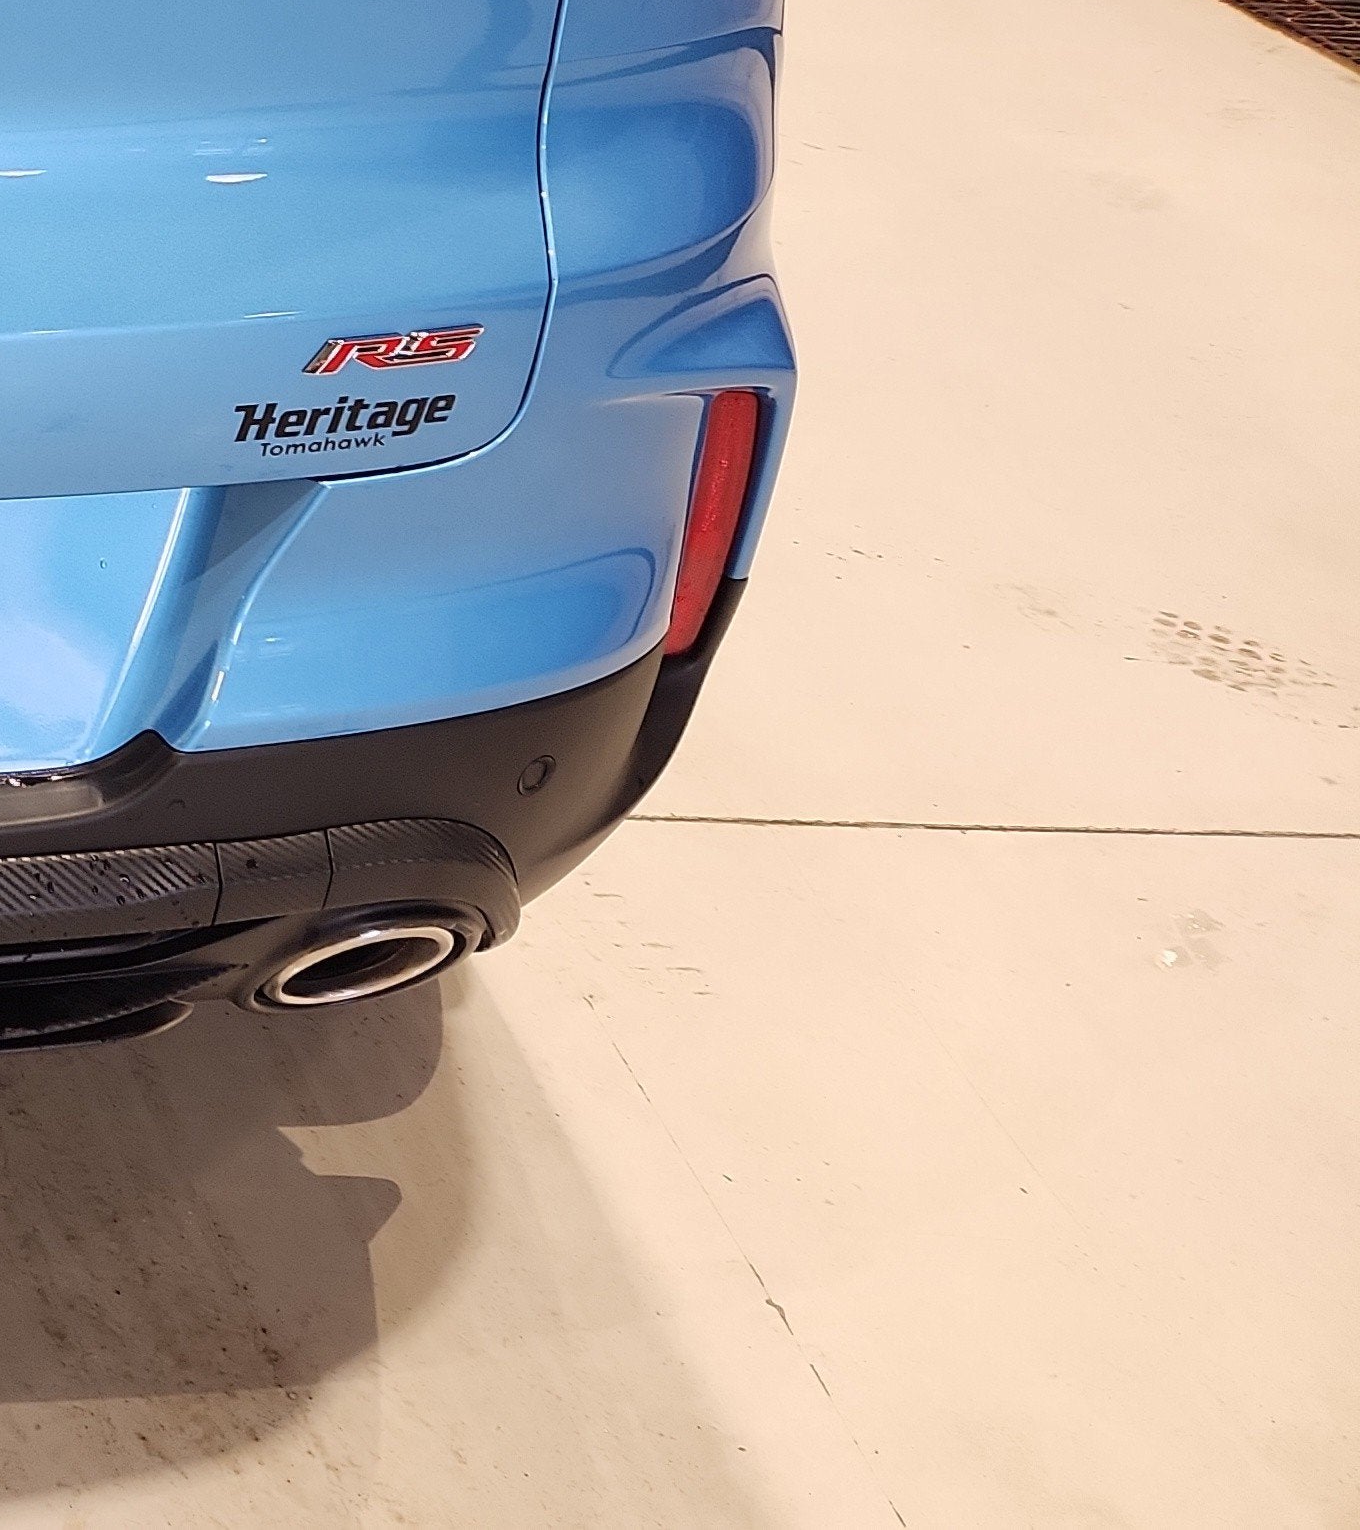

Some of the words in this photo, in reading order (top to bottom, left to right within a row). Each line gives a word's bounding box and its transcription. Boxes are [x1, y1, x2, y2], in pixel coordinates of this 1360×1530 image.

[301, 322, 485, 375] RS
[234, 394, 456, 442] Heritage
[261, 433, 386, 457] Tomahawk
